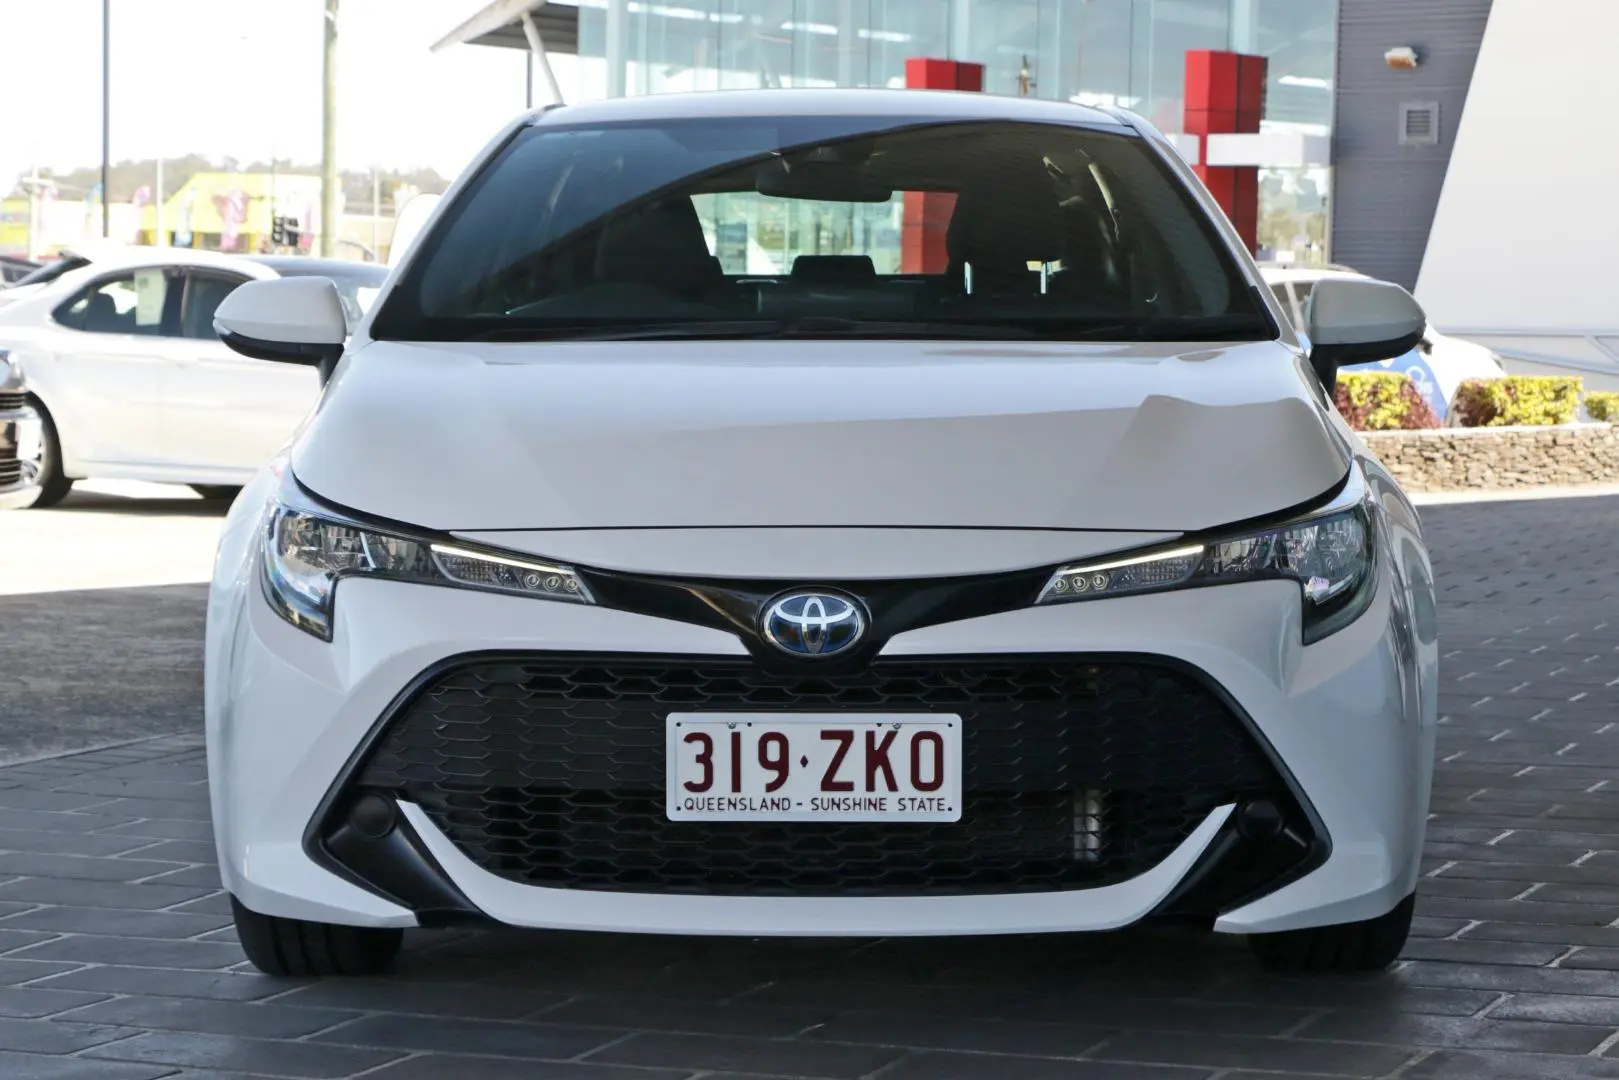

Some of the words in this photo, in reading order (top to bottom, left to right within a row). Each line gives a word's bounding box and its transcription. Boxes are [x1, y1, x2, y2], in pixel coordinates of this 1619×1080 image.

[684, 797, 791, 811] QUEENSLAND
[811, 797, 887, 811] SUNSHINE
[898, 797, 945, 811] STATE
